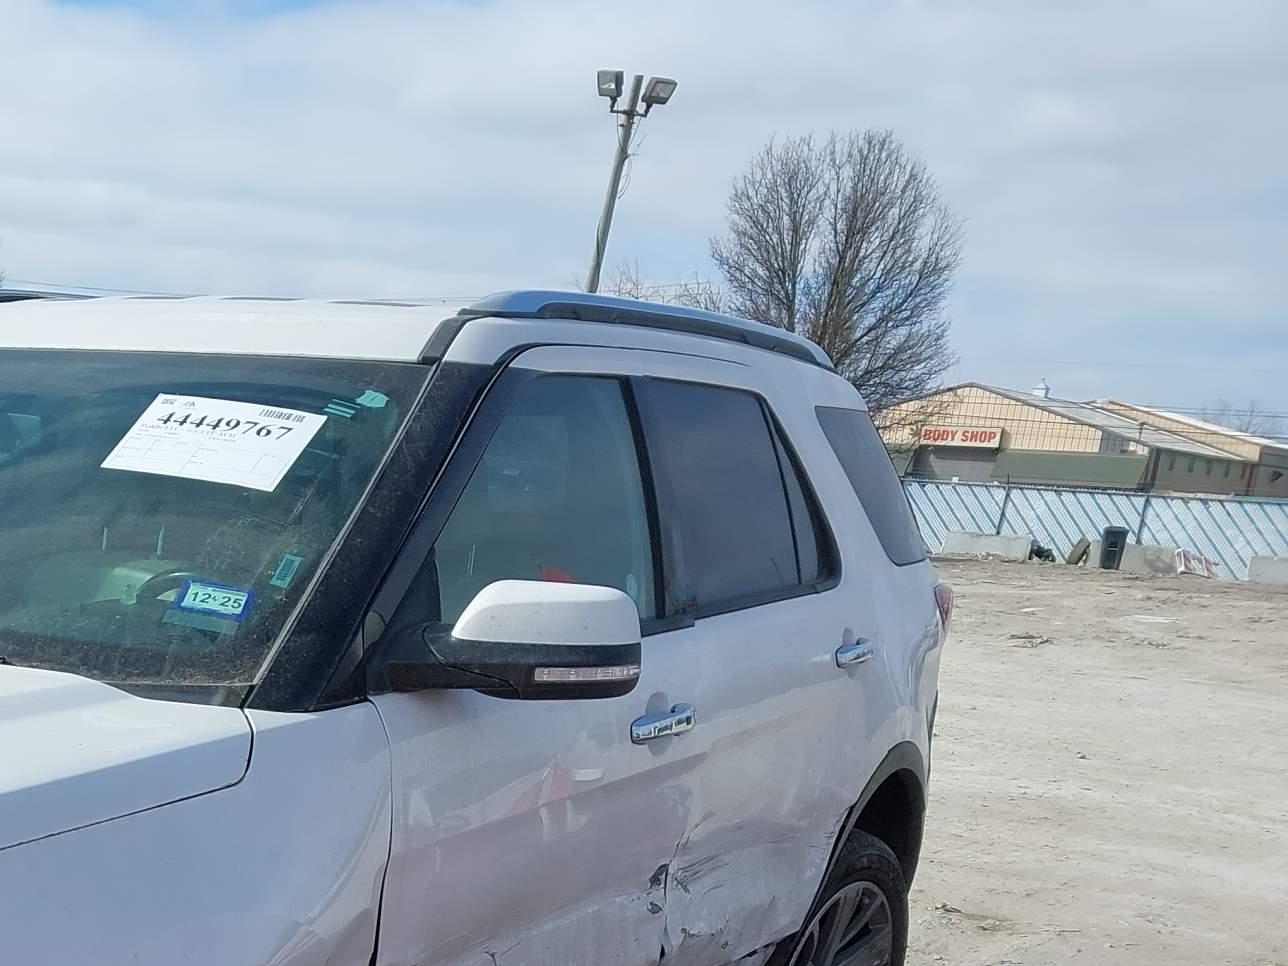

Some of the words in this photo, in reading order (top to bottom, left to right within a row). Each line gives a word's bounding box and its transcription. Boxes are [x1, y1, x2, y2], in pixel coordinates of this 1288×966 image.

[157, 411, 294, 440] 44449767
[923, 429, 958, 442] BODY
[960, 430, 997, 443] SHOP
[191, 591, 212, 604] 12
[219, 595, 244, 609] 25
